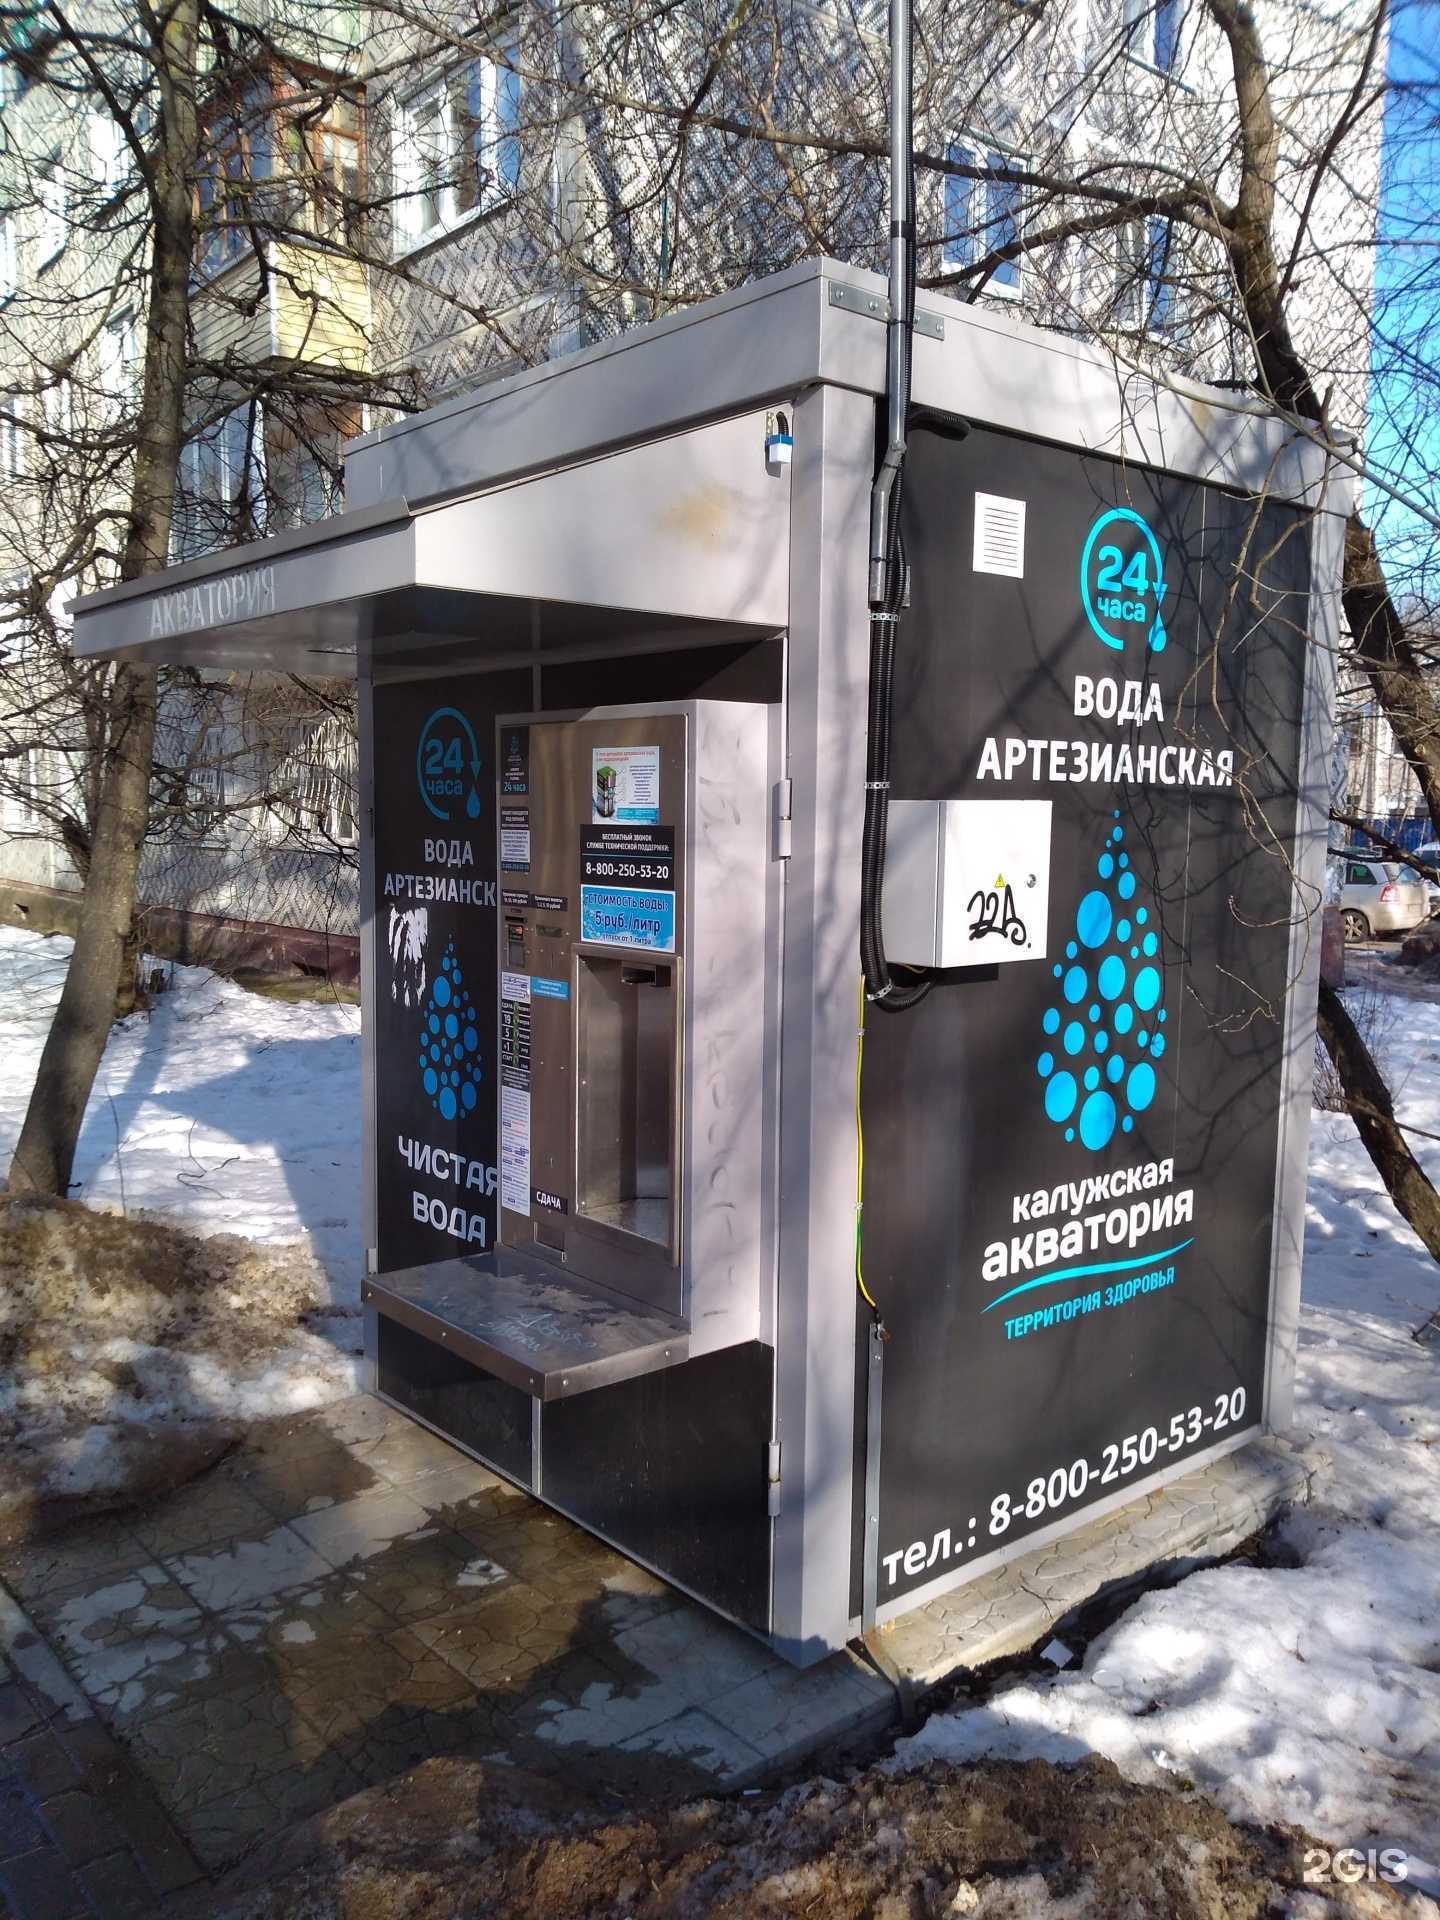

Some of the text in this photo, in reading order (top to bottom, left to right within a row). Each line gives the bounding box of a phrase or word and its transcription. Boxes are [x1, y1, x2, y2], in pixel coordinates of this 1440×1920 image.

[1097, 545, 1149, 597] 24
[150, 565, 276, 637] АКВАТОРИЯ
[1097, 597, 1146, 623] часа
[1074, 675, 1165, 727] ВОДА
[425, 737, 464, 774] 24
[976, 737, 1234, 787] АРТЕЗИАНСКАЯ
[426, 778, 464, 796] часа
[424, 838, 474, 868] ВОДА
[585, 862, 669, 879] 8-800-250-53-20
[588, 893, 669, 911] СТОИМОСТЬ ВОДЫ:
[595, 911, 602, 925] 5
[398, 1135, 497, 1197] ЧИСТАЯ
[1012, 1157, 1174, 1223] калужская
[413, 1190, 486, 1248] ВОДА
[536, 1191, 561, 1209] СДАЧА
[981, 1189, 1194, 1281] акватория
[1005, 1267, 1175, 1340] ТЕРРИТОРИЯ ЗДОРОВЬЯ
[882, 1386, 1246, 1586] тел.: 8-800-250-53-20
